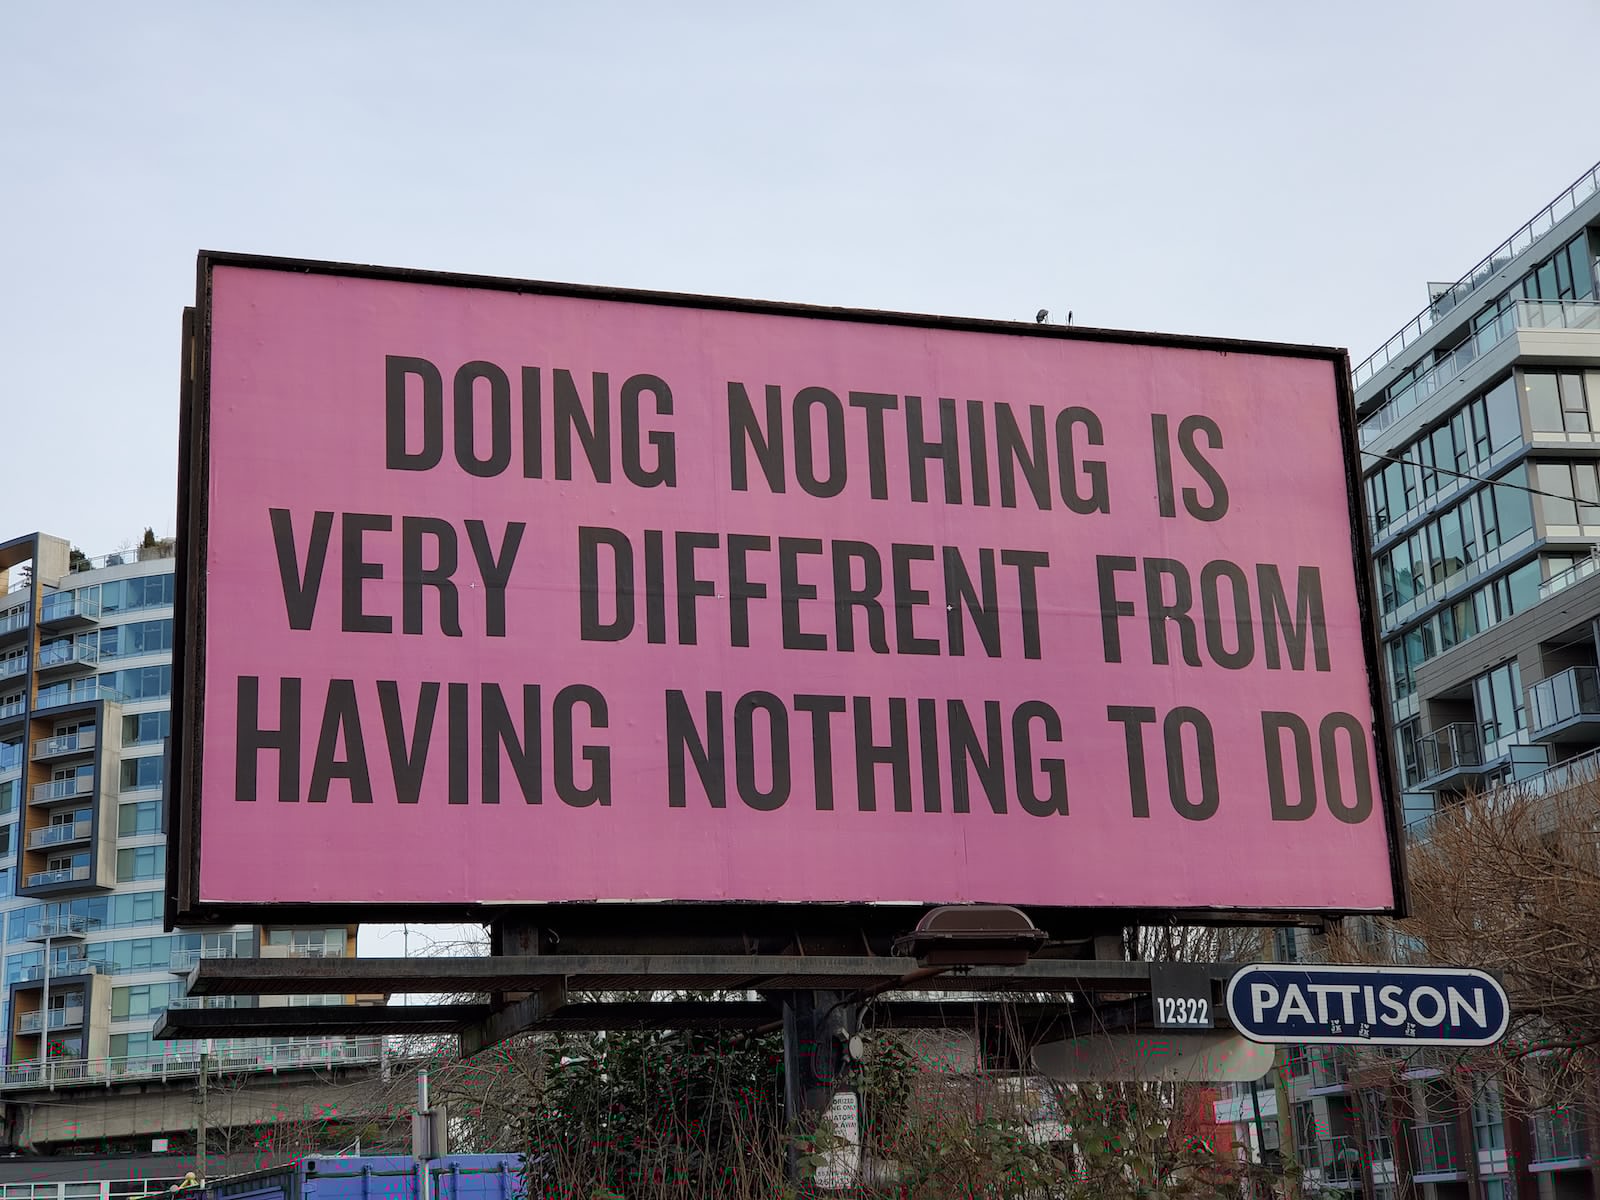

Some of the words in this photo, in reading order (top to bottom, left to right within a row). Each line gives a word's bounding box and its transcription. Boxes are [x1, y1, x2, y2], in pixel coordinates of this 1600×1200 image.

[386, 355, 676, 488] DOING
[728, 382, 1110, 514] NOTHING
[1151, 414, 1228, 522] IS
[269, 508, 526, 638] VERY
[579, 526, 1049, 661] DIFFERENT
[1096, 555, 1331, 672] FROM
[235, 676, 611, 808] HAVING
[665, 690, 1069, 817] NOTHING
[1107, 705, 1219, 821] TO
[1261, 711, 1373, 824] DO
[1157, 997, 1209, 1025] 12322
[1250, 983, 1488, 1028] PATTISON
